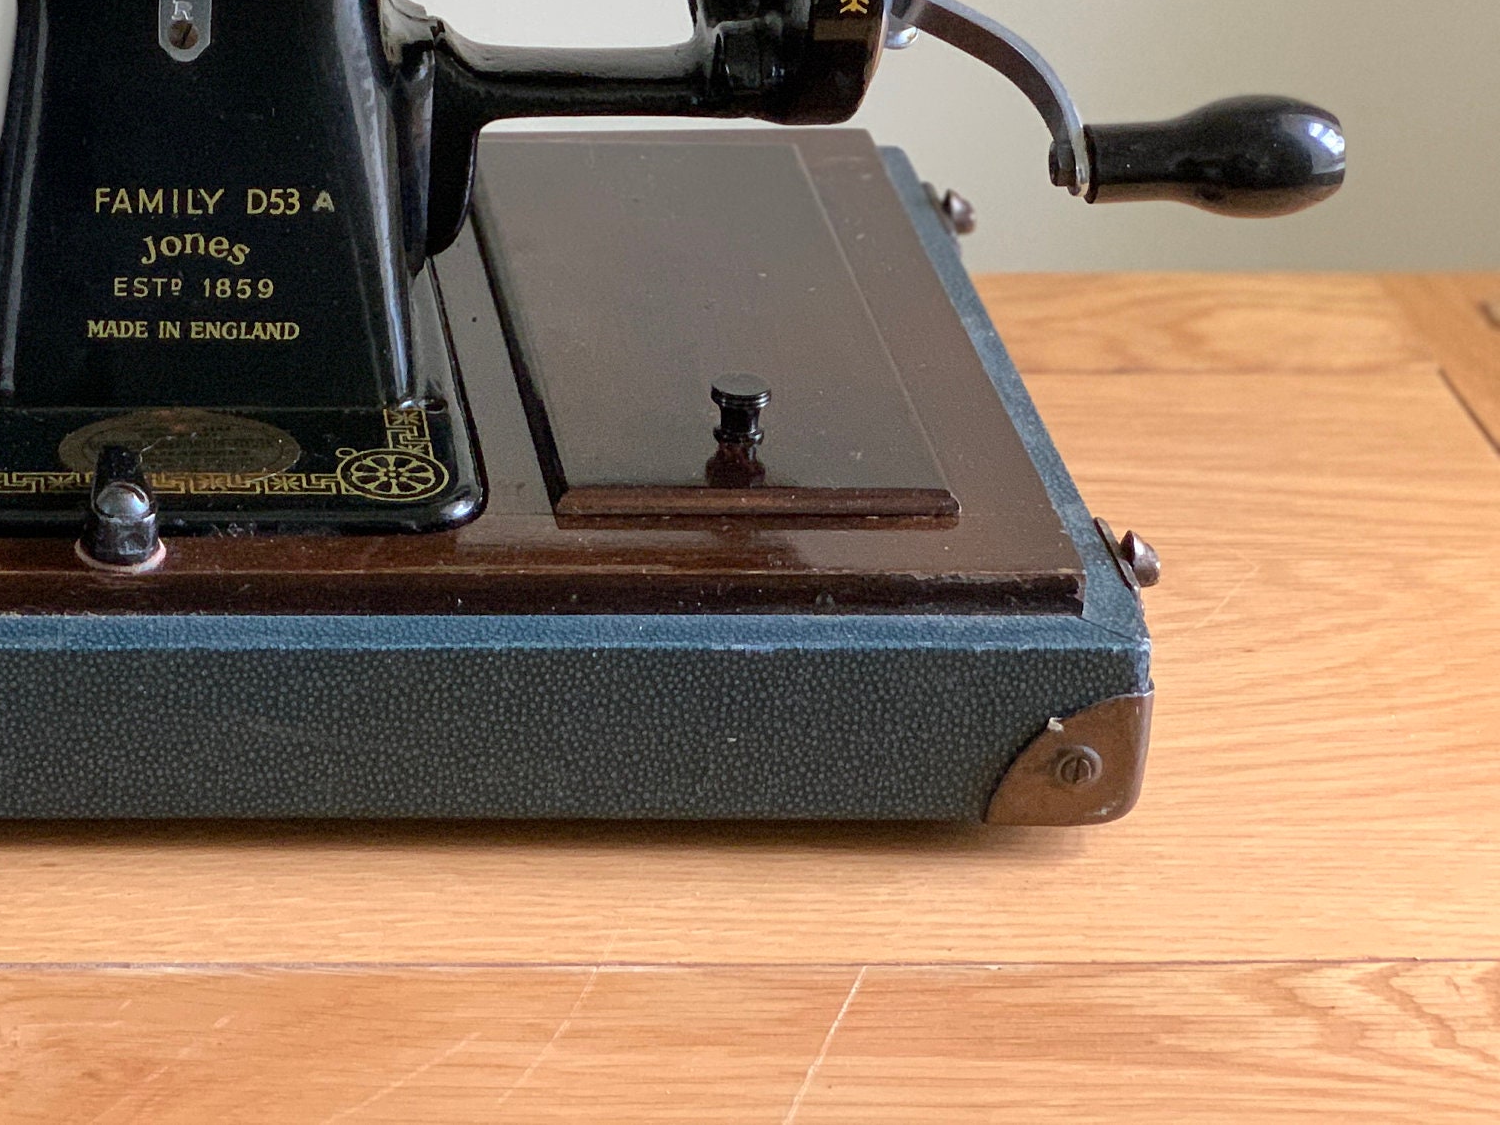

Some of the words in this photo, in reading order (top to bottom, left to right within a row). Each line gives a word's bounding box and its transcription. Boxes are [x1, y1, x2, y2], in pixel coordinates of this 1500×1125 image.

[171, 0, 194, 21] R
[96, 188, 224, 214] FAMILY
[247, 188, 300, 214] D53
[313, 191, 334, 211] A
[204, 279, 273, 298] 1859
[88, 321, 148, 338] MADE
[159, 321, 180, 338] IN
[191, 322, 299, 340] ENGLAND
